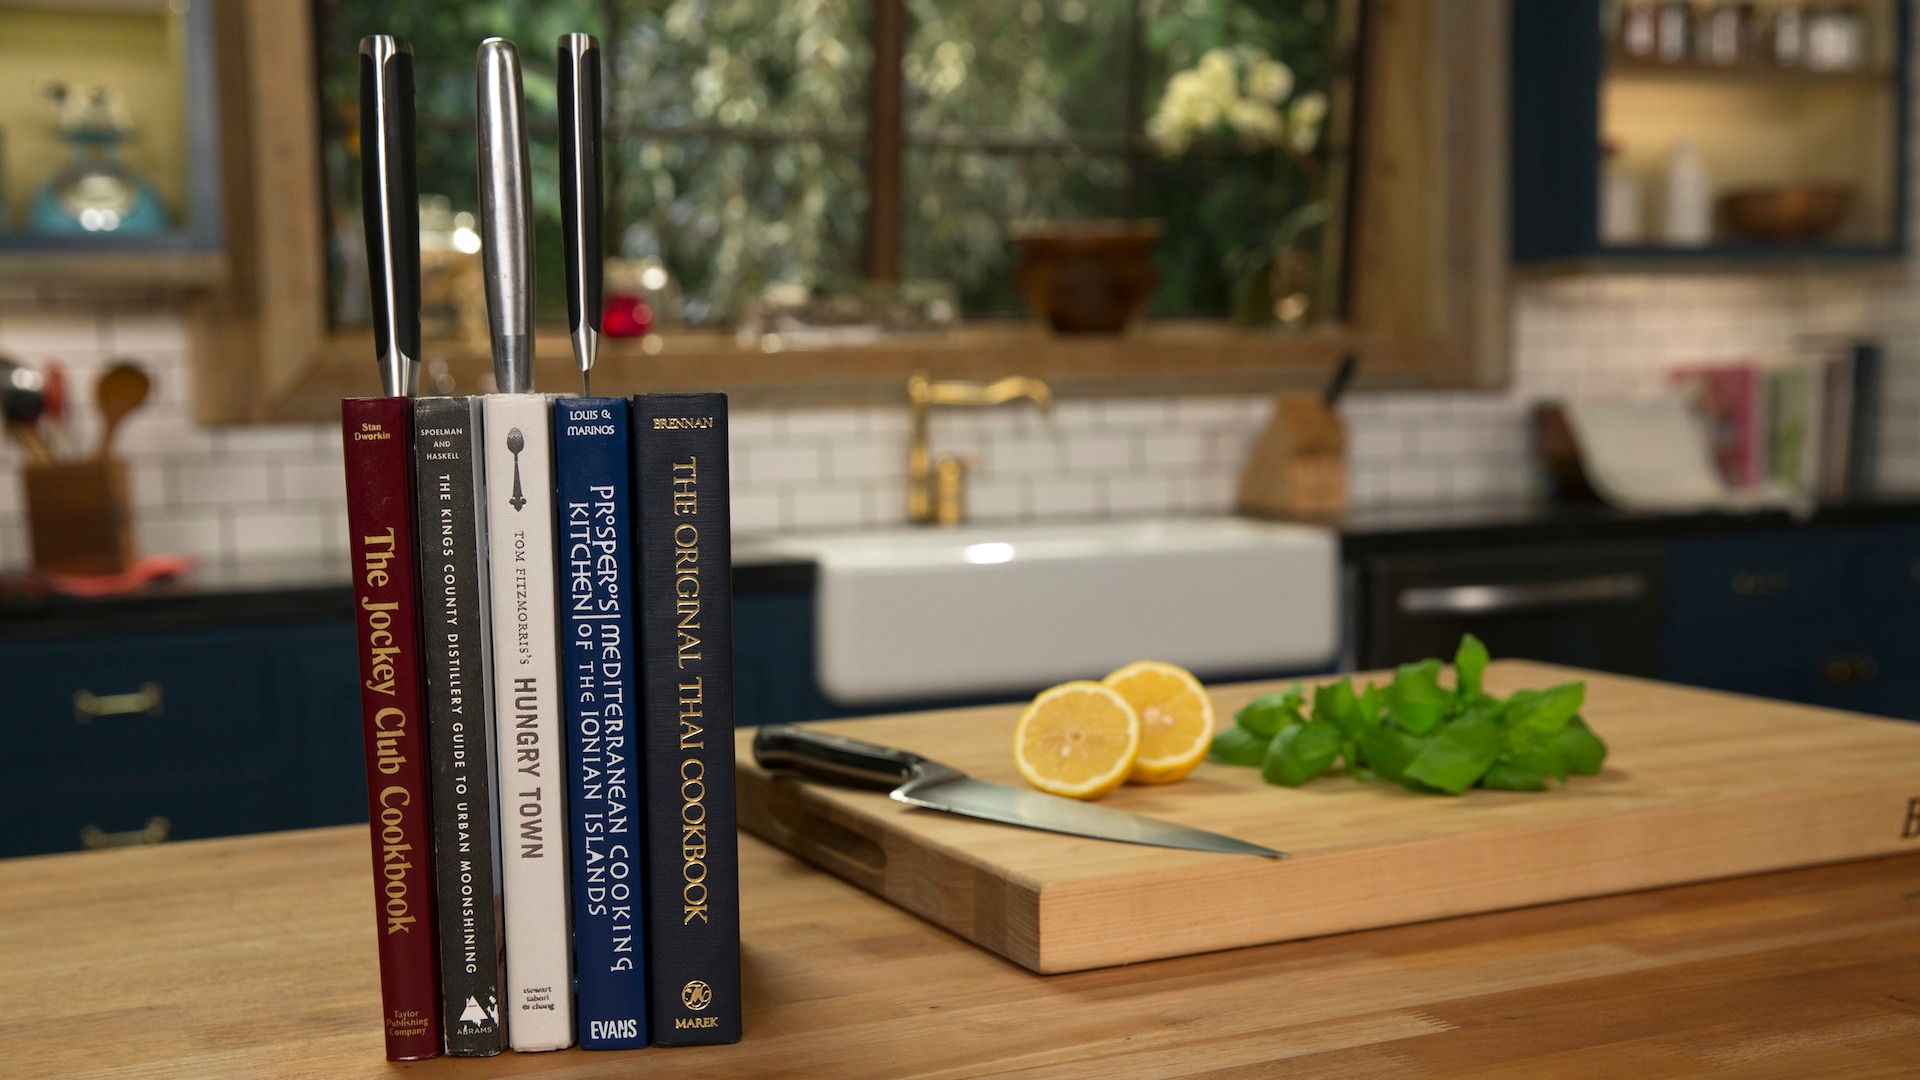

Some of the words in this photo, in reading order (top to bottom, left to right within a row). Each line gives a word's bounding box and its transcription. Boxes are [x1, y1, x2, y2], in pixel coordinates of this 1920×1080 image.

[354, 431, 391, 441] Dworkin
[361, 422, 382, 432] Stan
[420, 427, 463, 437] SPOELMAN
[567, 425, 616, 436] MARINOS
[569, 410, 600, 421] LOUIS
[652, 416, 714, 430] BRENNAN
[426, 452, 459, 460] HASKELL
[433, 440, 451, 448] AND
[439, 473, 451, 501] THE
[672, 456, 698, 516] THE
[364, 526, 396, 588] The
[440, 508, 454, 557] KINGS
[514, 531, 526, 562] TOM
[569, 502, 593, 611] KITCHEN
[442, 564, 458, 626] COUNTY
[516, 568, 532, 666] FITZMORRIS'S
[673, 522, 704, 670] ORIGINAL
[362, 596, 404, 697] Jockey
[577, 623, 595, 650] OF
[447, 632, 463, 716] DISTILLERY
[578, 661, 597, 701] THE
[514, 678, 541, 777] HUNGRY
[601, 624, 628, 835] MEDITERRANEAN
[677, 675, 706, 751] THAI
[374, 706, 408, 776] Club
[452, 721, 466, 770] GUIDE
[580, 709, 601, 800] IONIAN
[455, 775, 468, 795] TO
[457, 802, 471, 853] URBAN
[518, 786, 545, 861] TOWN
[680, 758, 709, 926] COOKBOOK
[378, 784, 418, 935] Cookbook
[585, 813, 608, 915] ISLANDS
[461, 860, 477, 974] MOONSHINING
[608, 844, 633, 972] COOKING
[387, 1018, 429, 1028] Publishing
[389, 1026, 427, 1037] Company
[394, 1010, 419, 1020] Taylor
[456, 1026, 493, 1036] ABRAMS
[531, 1003, 556, 1011] chang
[590, 1018, 638, 1041] EVANS
[675, 1016, 719, 1029] MAREK
